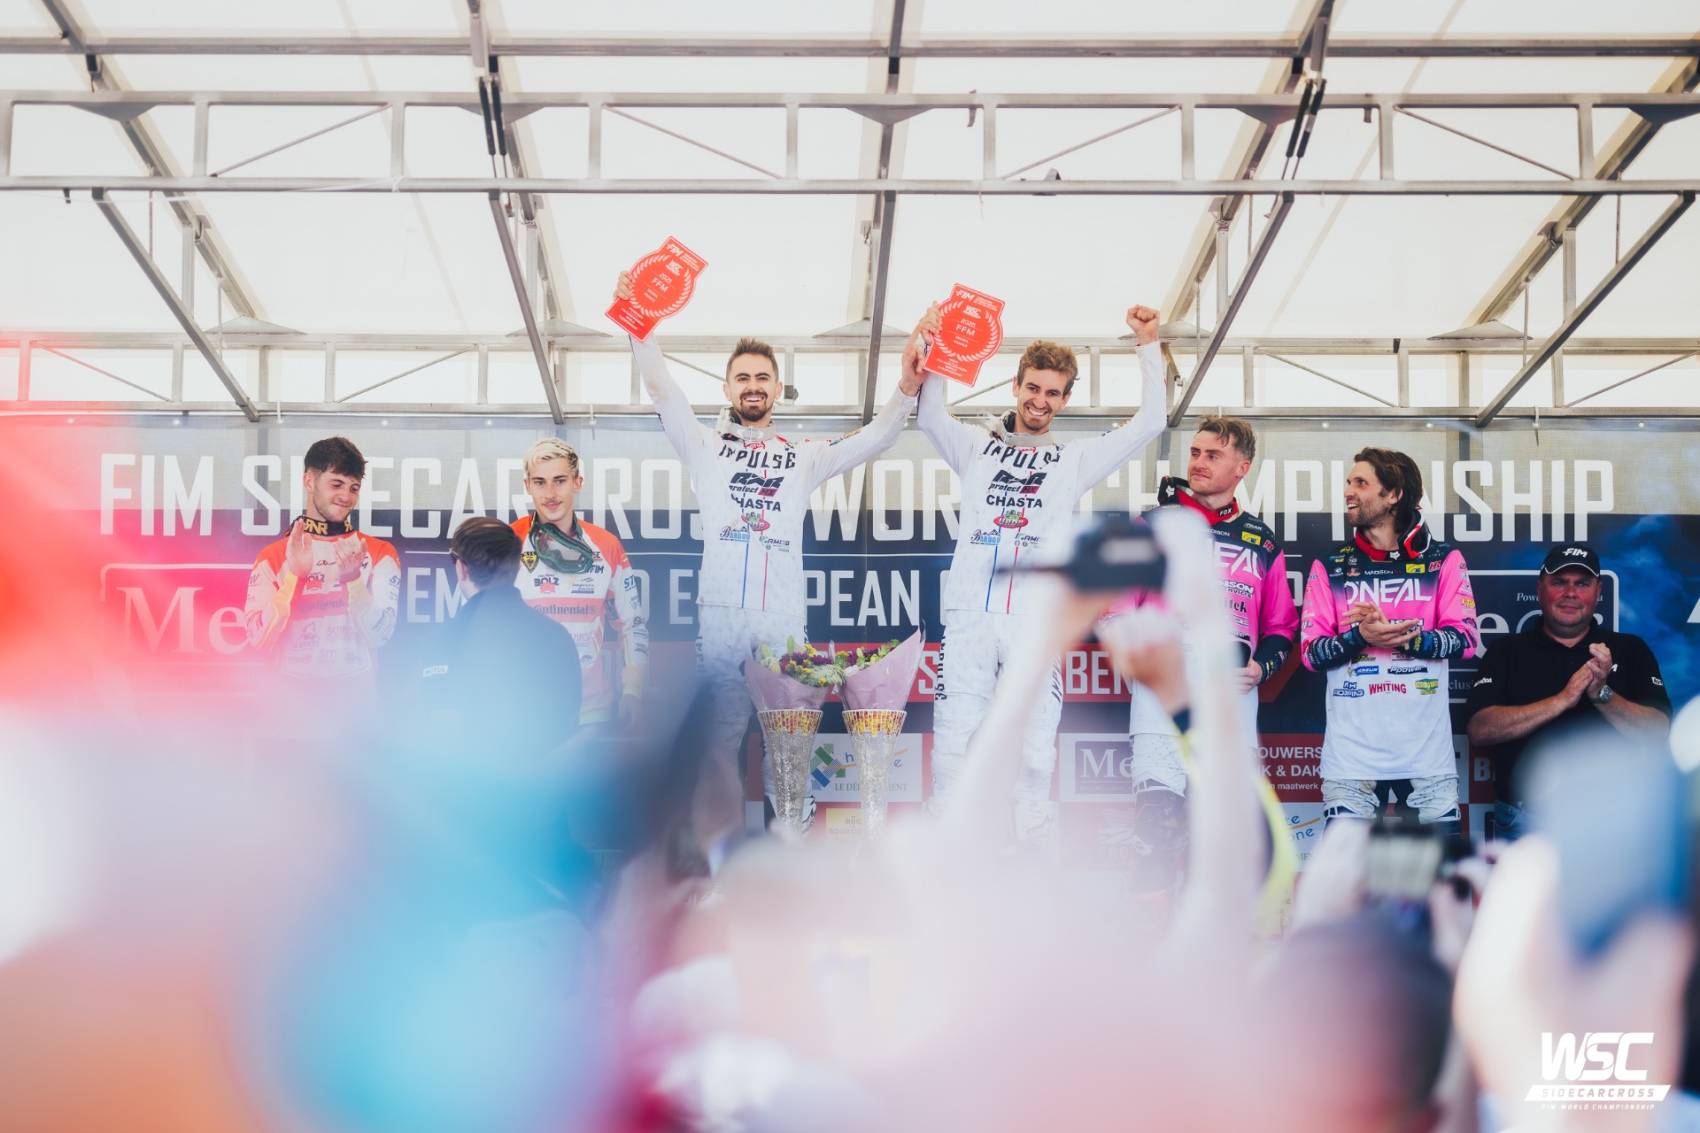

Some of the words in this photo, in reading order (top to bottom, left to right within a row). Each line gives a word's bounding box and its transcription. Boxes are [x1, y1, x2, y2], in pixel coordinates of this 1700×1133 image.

[100, 453, 214, 537] FIM
[986, 494, 1043, 508] CHASTA
[1219, 507, 1232, 516] FOX
[1562, 547, 1588, 558] FIM
[534, 576, 560, 587] BOLZ
[1368, 682, 1407, 696] WHITING
[1259, 746, 1322, 759] OUWERS
[1276, 764, 1287, 777] &
[1277, 782, 1319, 790] maatwerk
